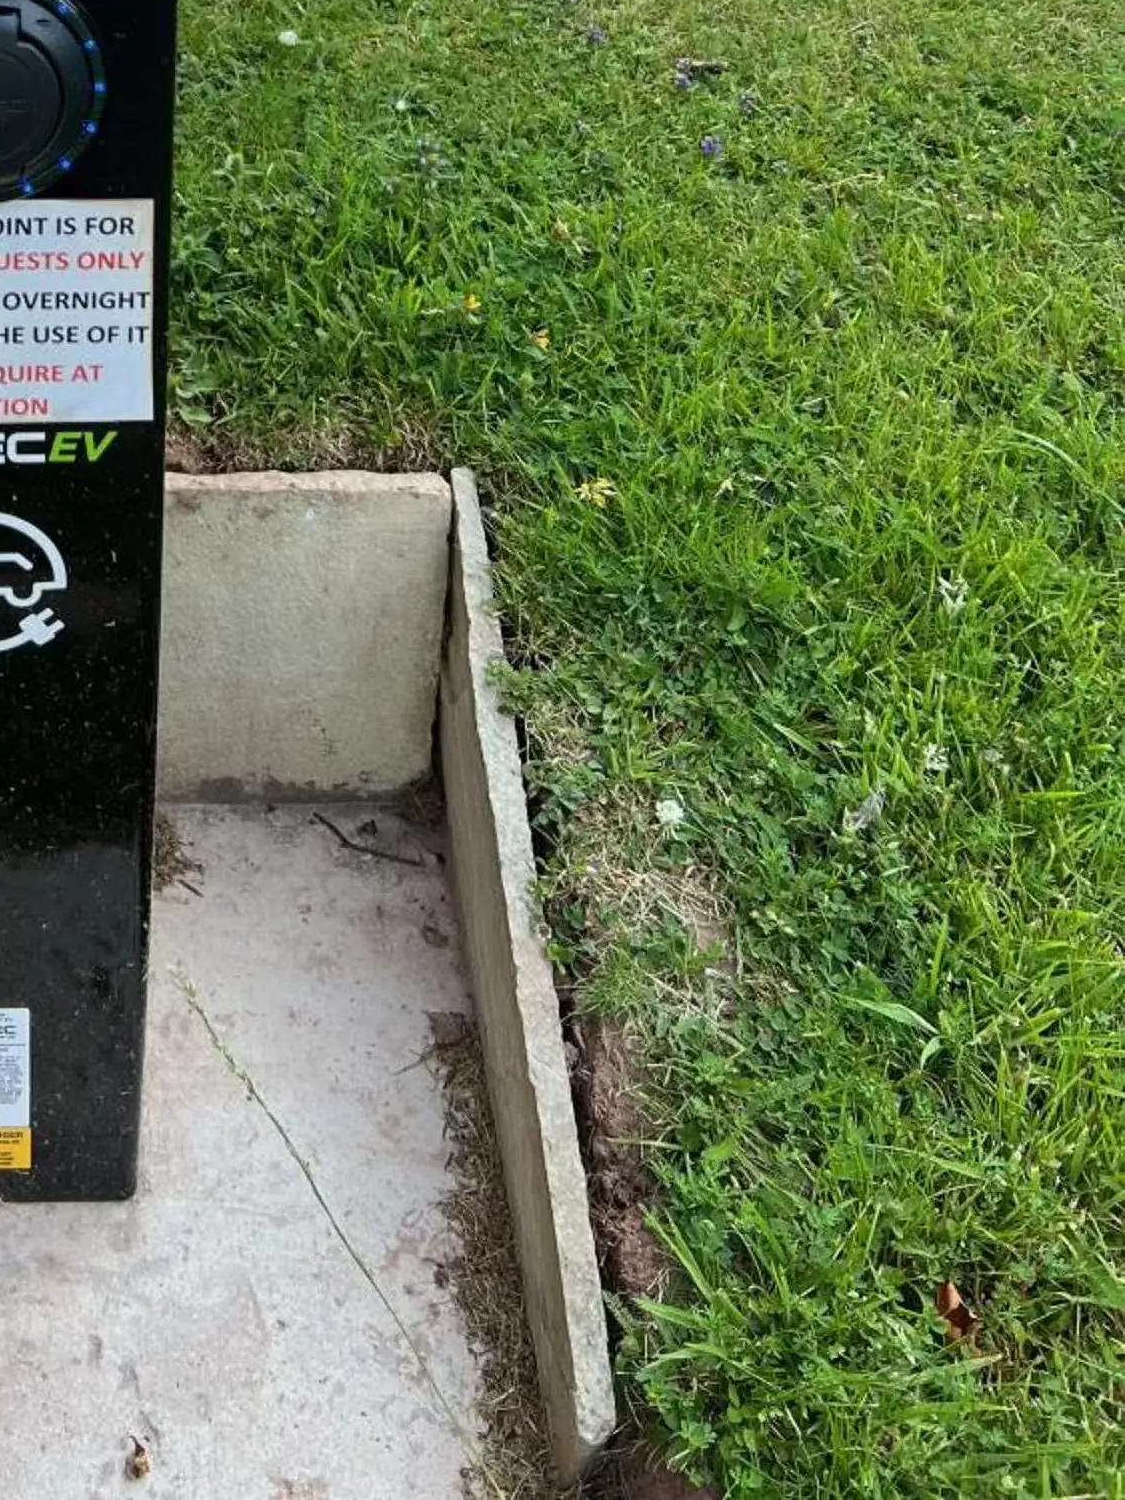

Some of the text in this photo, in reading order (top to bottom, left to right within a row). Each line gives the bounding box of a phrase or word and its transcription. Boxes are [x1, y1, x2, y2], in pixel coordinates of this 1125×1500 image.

[56, 217, 77, 235] IS
[85, 217, 135, 235] FOR
[76, 251, 145, 271] ONLY
[2, 291, 150, 310] OVERNIGHT
[33, 325, 79, 344] USE
[86, 325, 120, 344] OF
[127, 325, 149, 343] IT
[71, 365, 103, 382] AT
